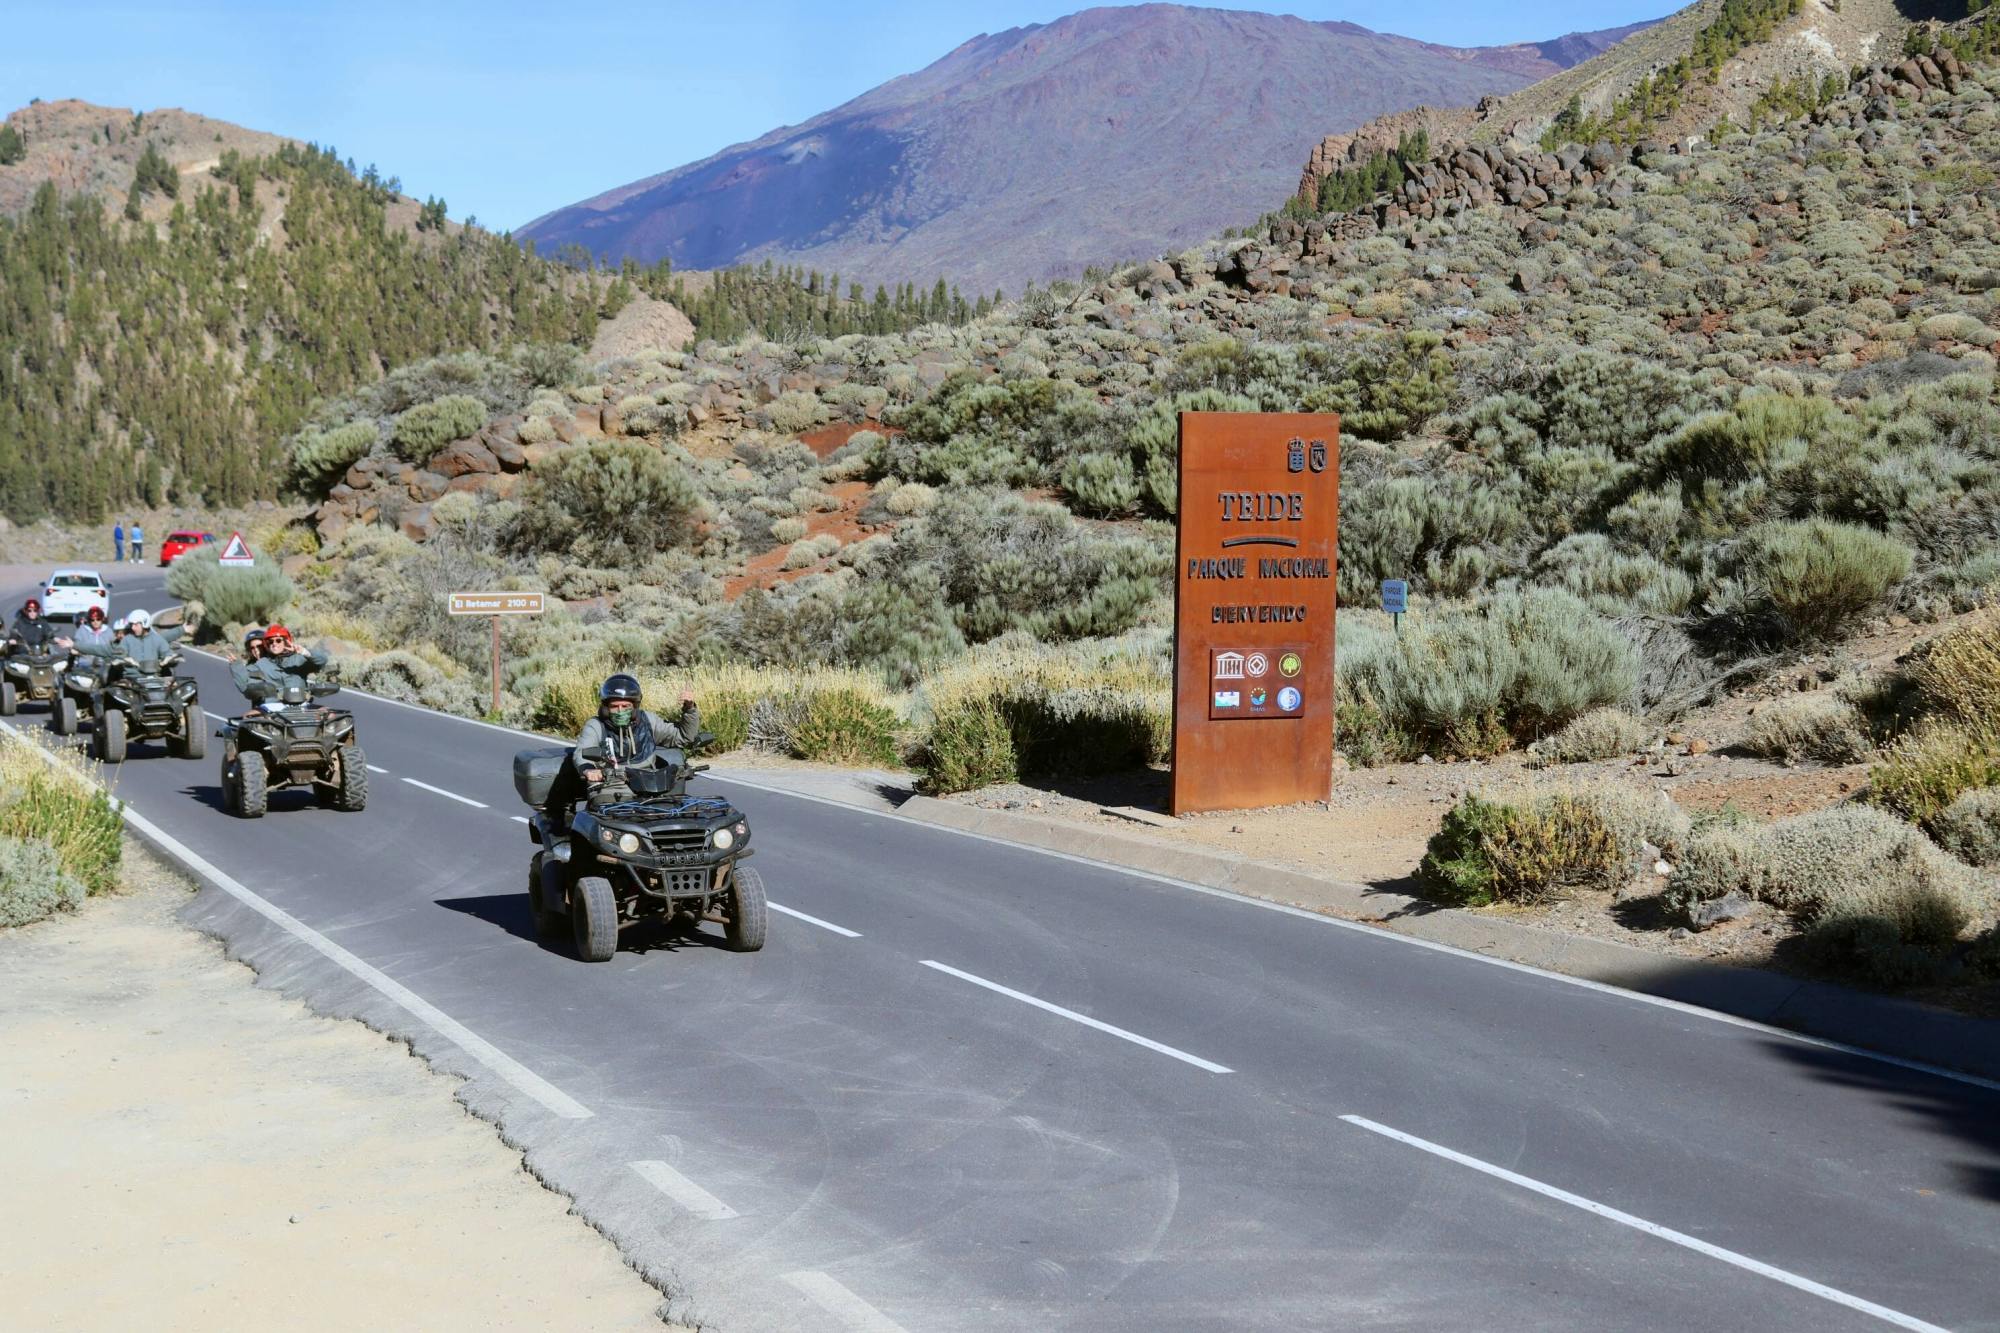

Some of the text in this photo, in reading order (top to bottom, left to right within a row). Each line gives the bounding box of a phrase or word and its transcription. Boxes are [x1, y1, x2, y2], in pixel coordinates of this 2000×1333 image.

[1218, 492, 1304, 521] TEIDE
[1187, 557, 1330, 580] PARQUE NACIONAL
[466, 600, 501, 608] Retamar
[507, 598, 526, 607] 2100
[1211, 604, 1306, 623] BIENVENIDO
